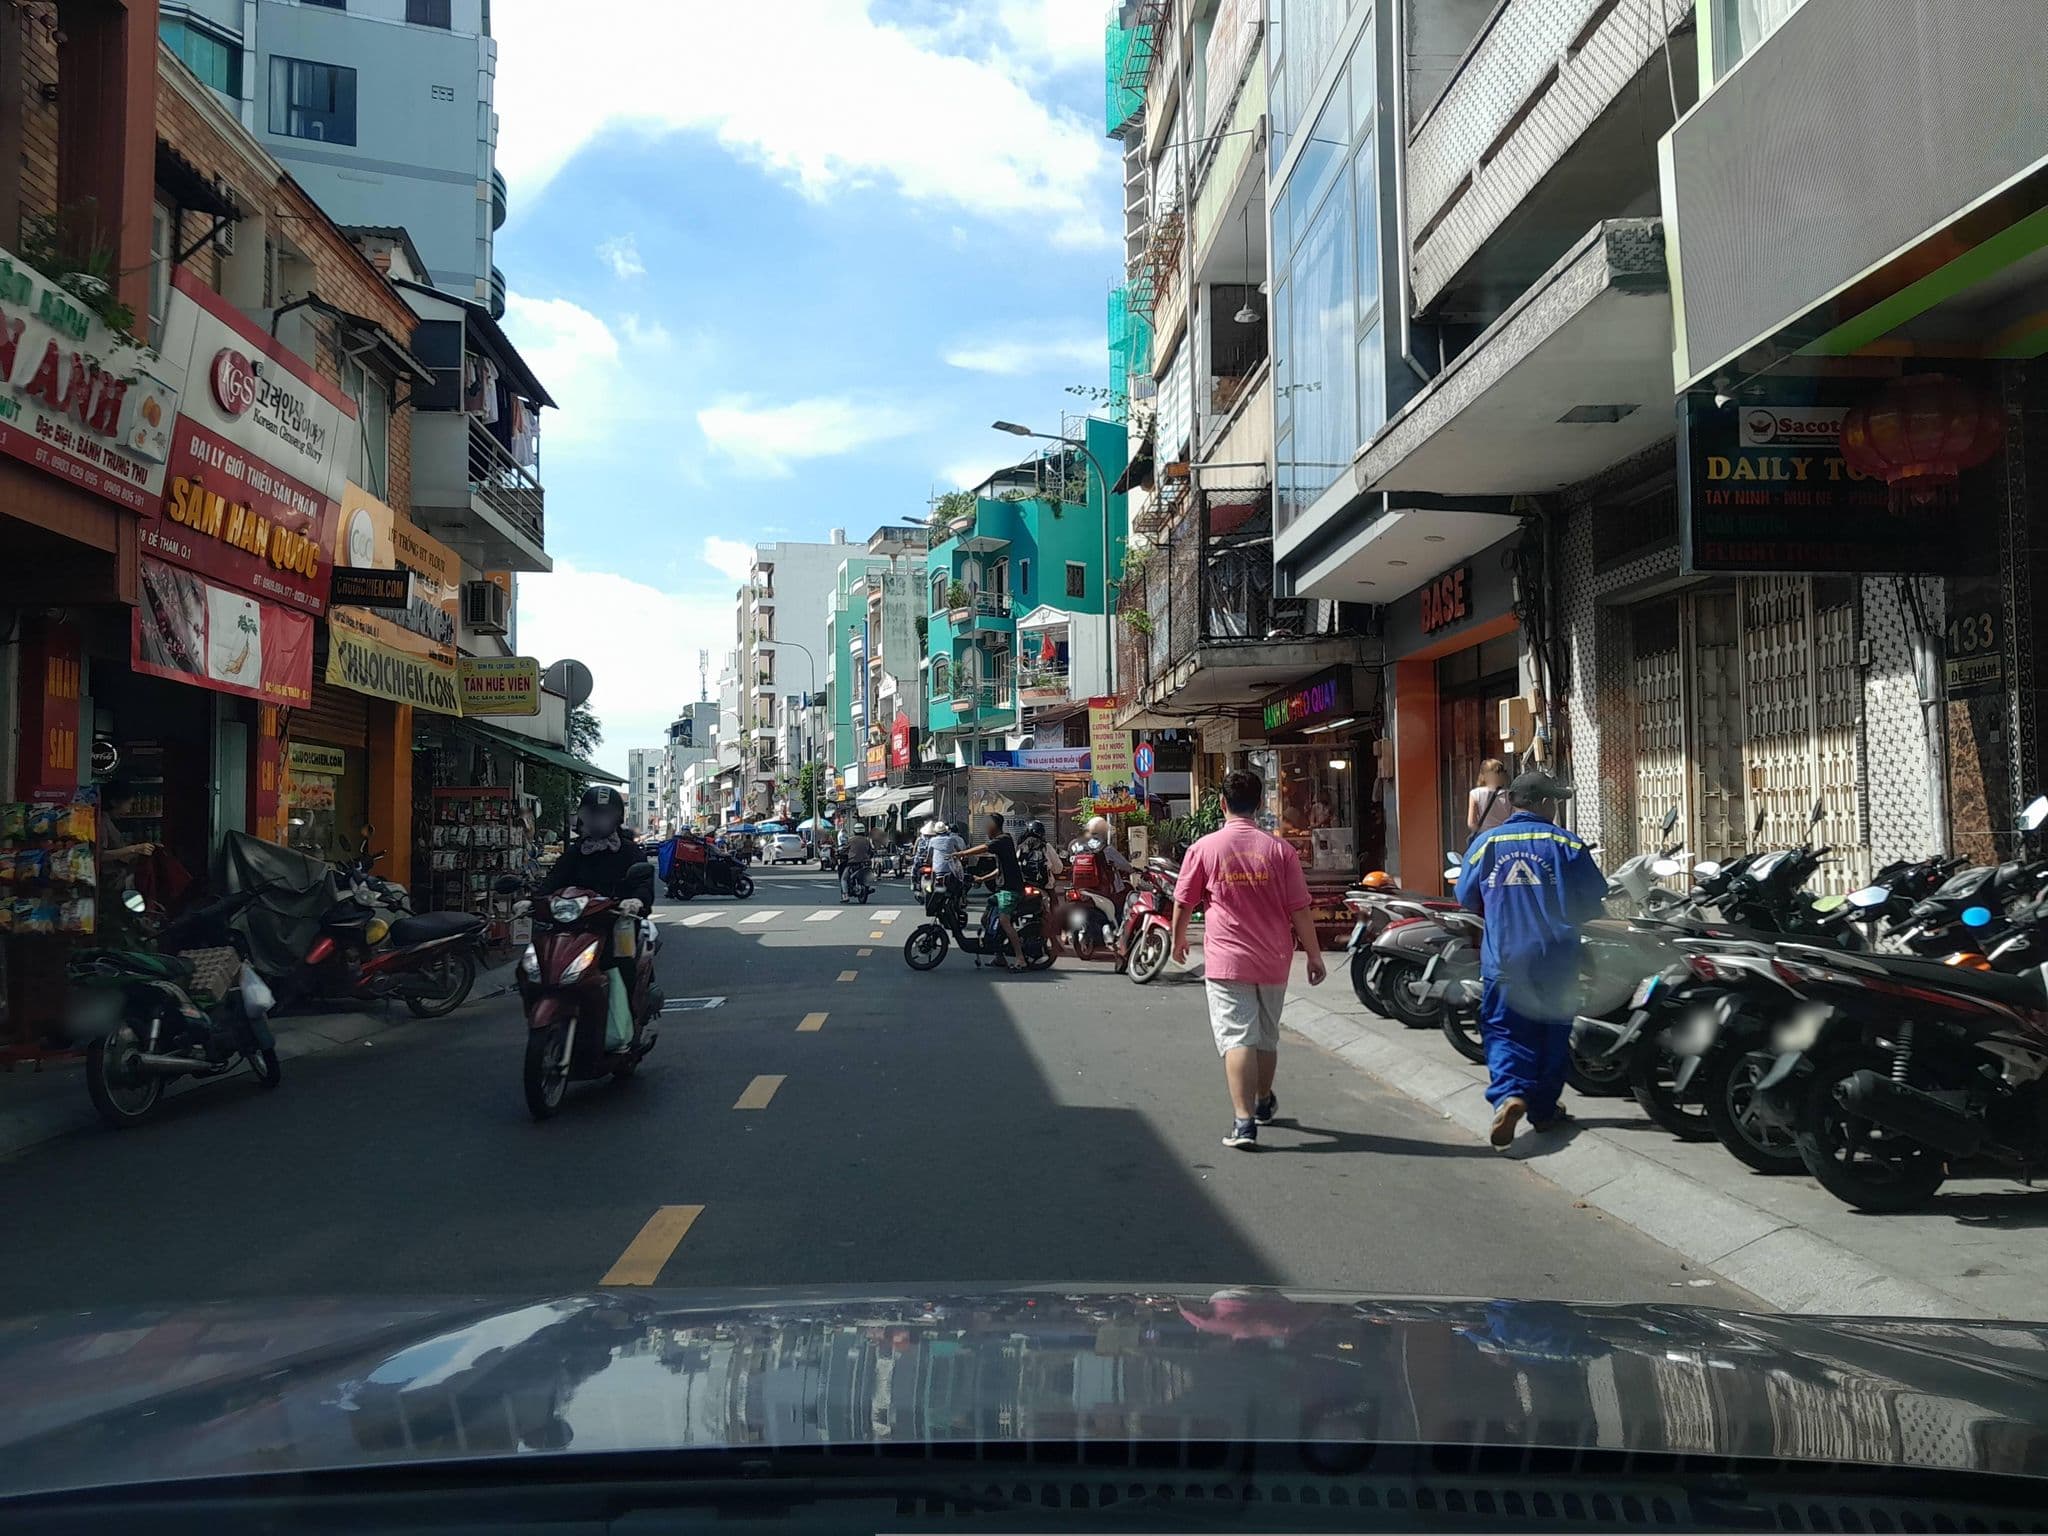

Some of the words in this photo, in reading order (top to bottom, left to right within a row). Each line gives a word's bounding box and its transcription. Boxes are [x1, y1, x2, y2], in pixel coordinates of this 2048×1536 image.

[220, 360, 256, 404] KGS
[253, 407, 279, 435] Korean
[1779, 417, 1841, 433] Sacot
[77, 435, 104, 462] BÁNH
[102, 449, 131, 477] TRUNG
[190, 436, 210, 466] ĐẠI
[211, 446, 225, 469] LÝ
[1707, 456, 1812, 481] DAILY
[1705, 489, 1729, 505] TAY
[1735, 489, 1770, 505] NINH
[1421, 568, 1466, 634] BASE
[1949, 612, 1994, 654] 133
[464, 674, 483, 692] TÂN
[508, 674, 530, 692] VIÊN
[1311, 679, 1337, 713] QUAY
